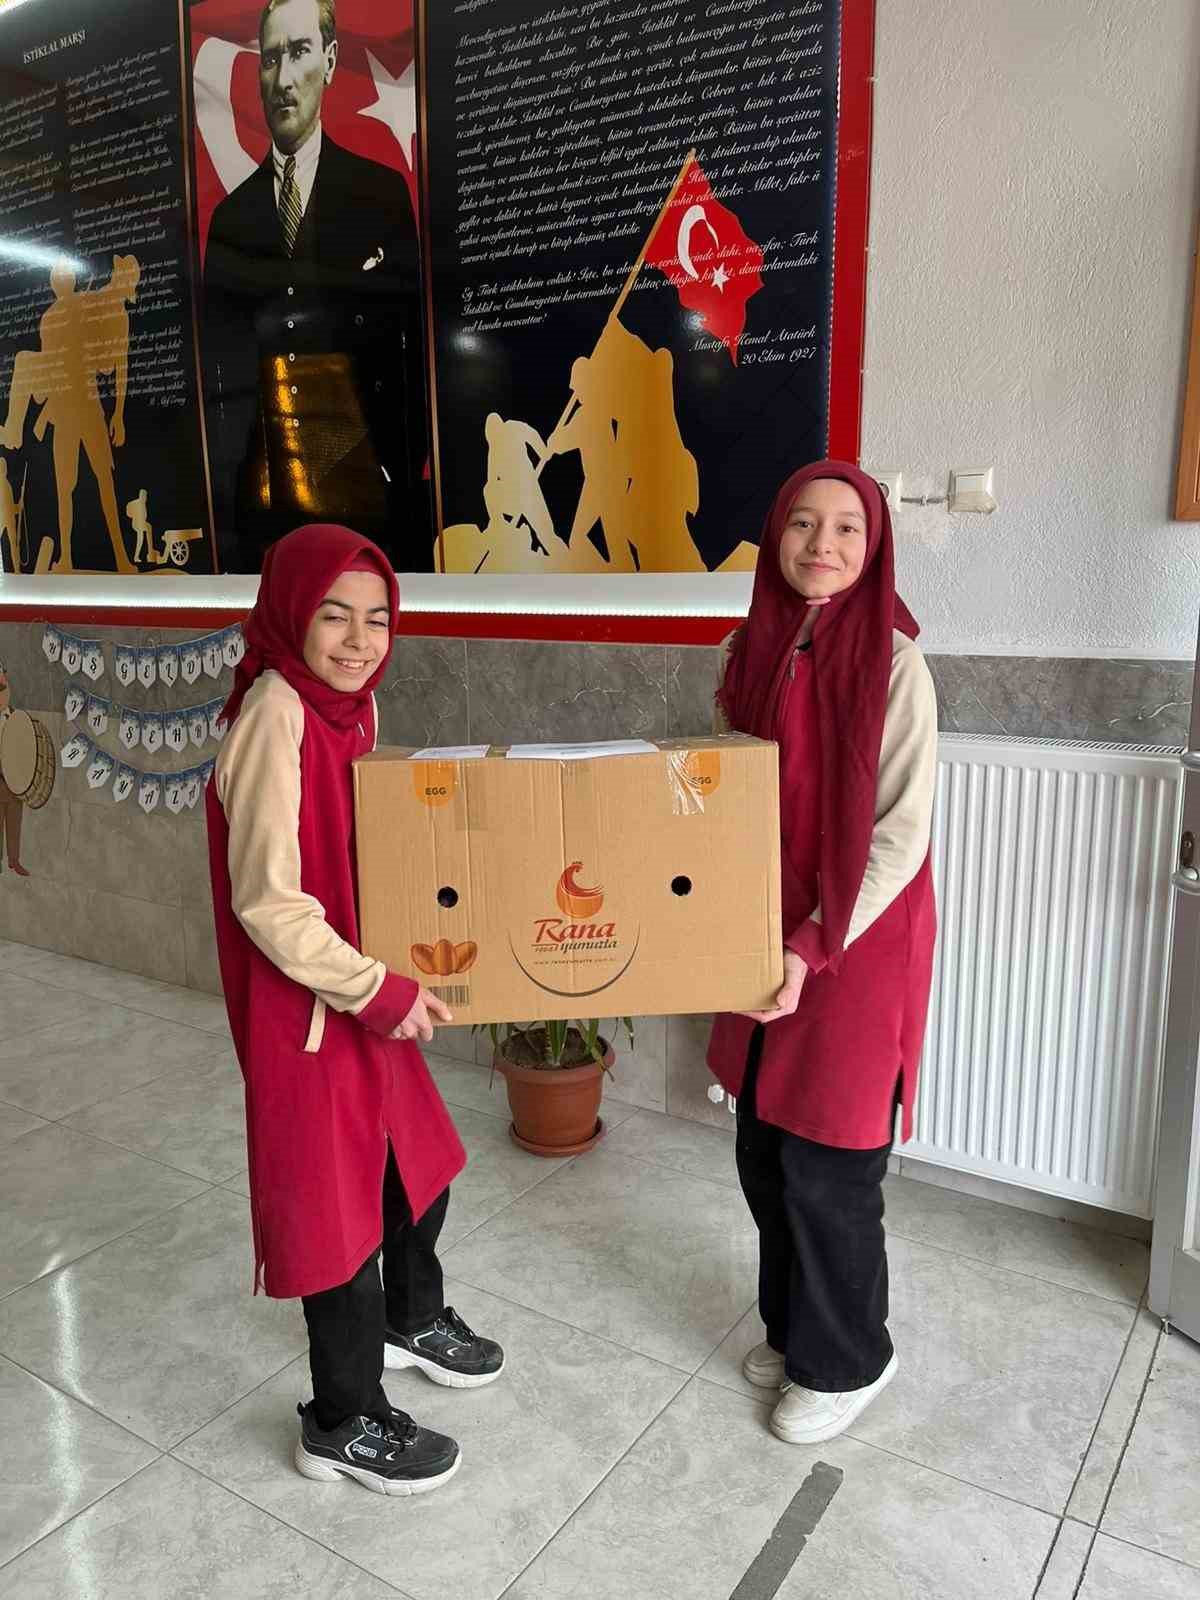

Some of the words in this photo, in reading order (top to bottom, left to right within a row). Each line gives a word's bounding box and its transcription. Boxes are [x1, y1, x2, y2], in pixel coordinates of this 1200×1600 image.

[742, 354, 757, 365] 20
[788, 347, 817, 362] 1927
[425, 787, 447, 797] EGG
[534, 918, 616, 944] Rana
